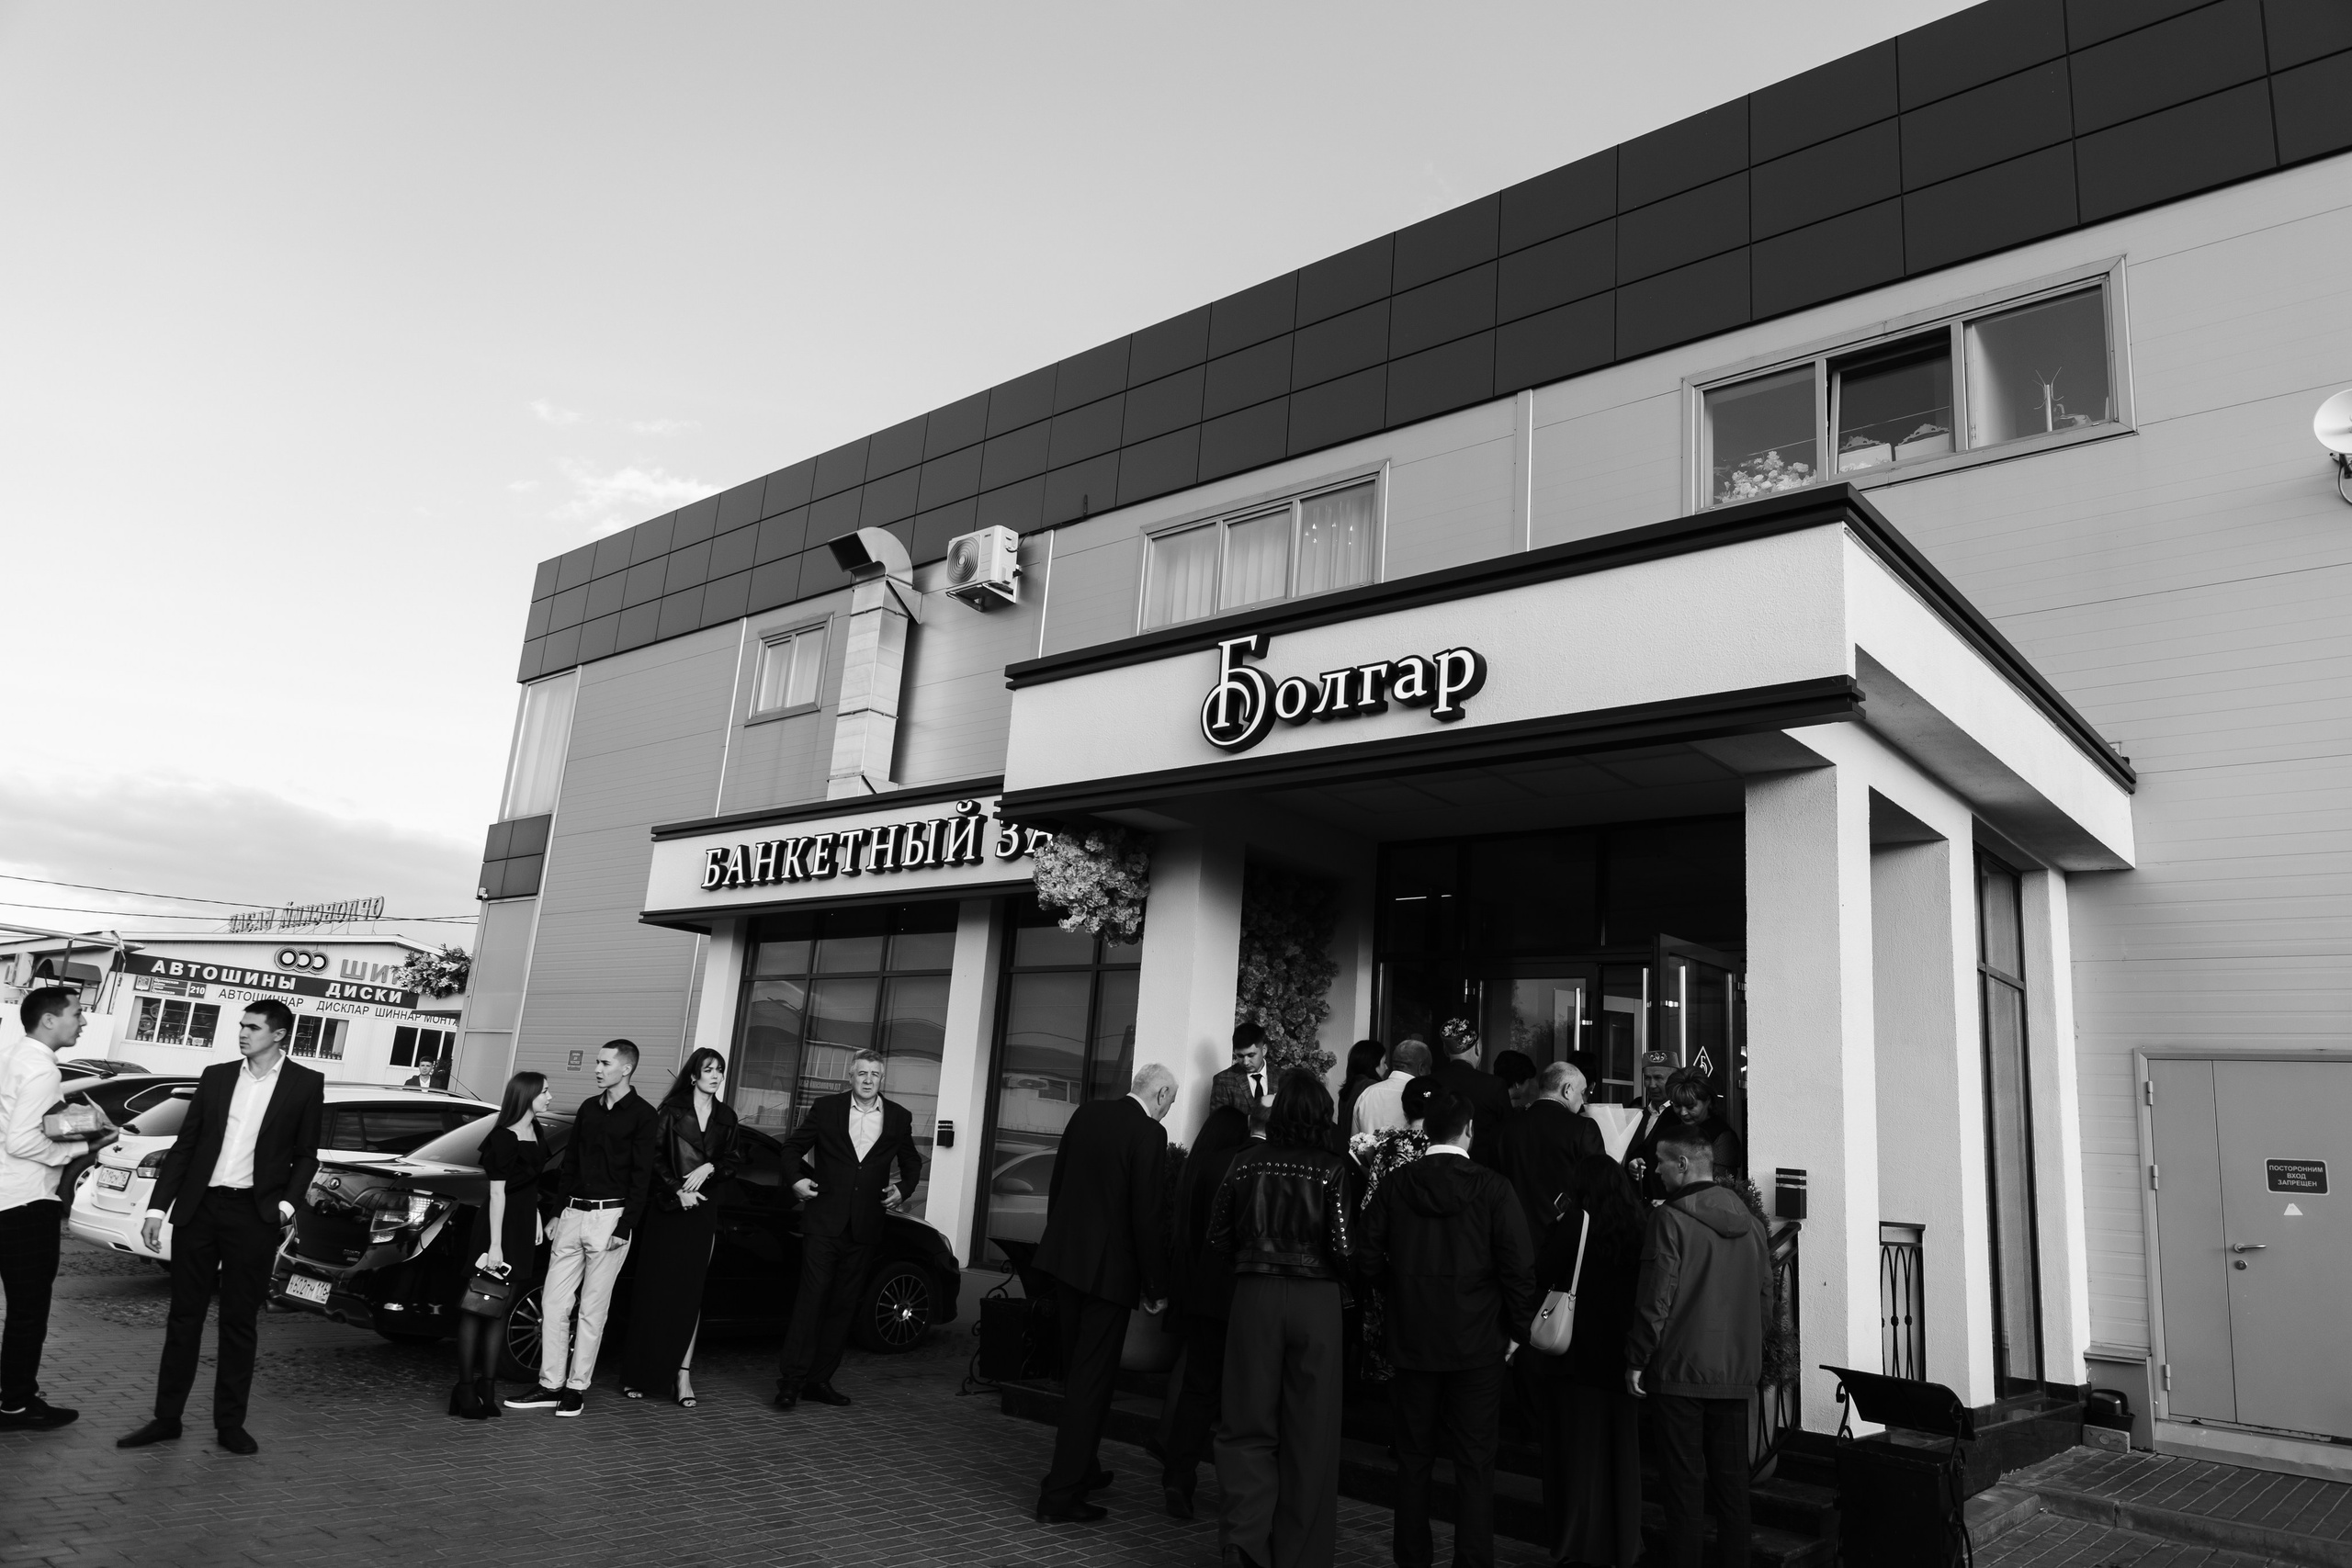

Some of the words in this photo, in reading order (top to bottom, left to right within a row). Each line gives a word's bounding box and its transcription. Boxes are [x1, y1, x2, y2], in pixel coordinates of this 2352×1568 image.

[1202, 634, 1487, 753] Болгар
[701, 800, 987, 890] БАНКЕТНЫЙ
[151, 960, 297, 990] АВТОШИНЫ
[325, 982, 402, 1004] ДИСКИ
[189, 986, 206, 995] 210
[316, 1000, 370, 1015] ДИСКЛАР
[375, 1007, 422, 1021] ШИННАР
[2268, 1165, 2324, 1173] ПОСТОРОННИМ
